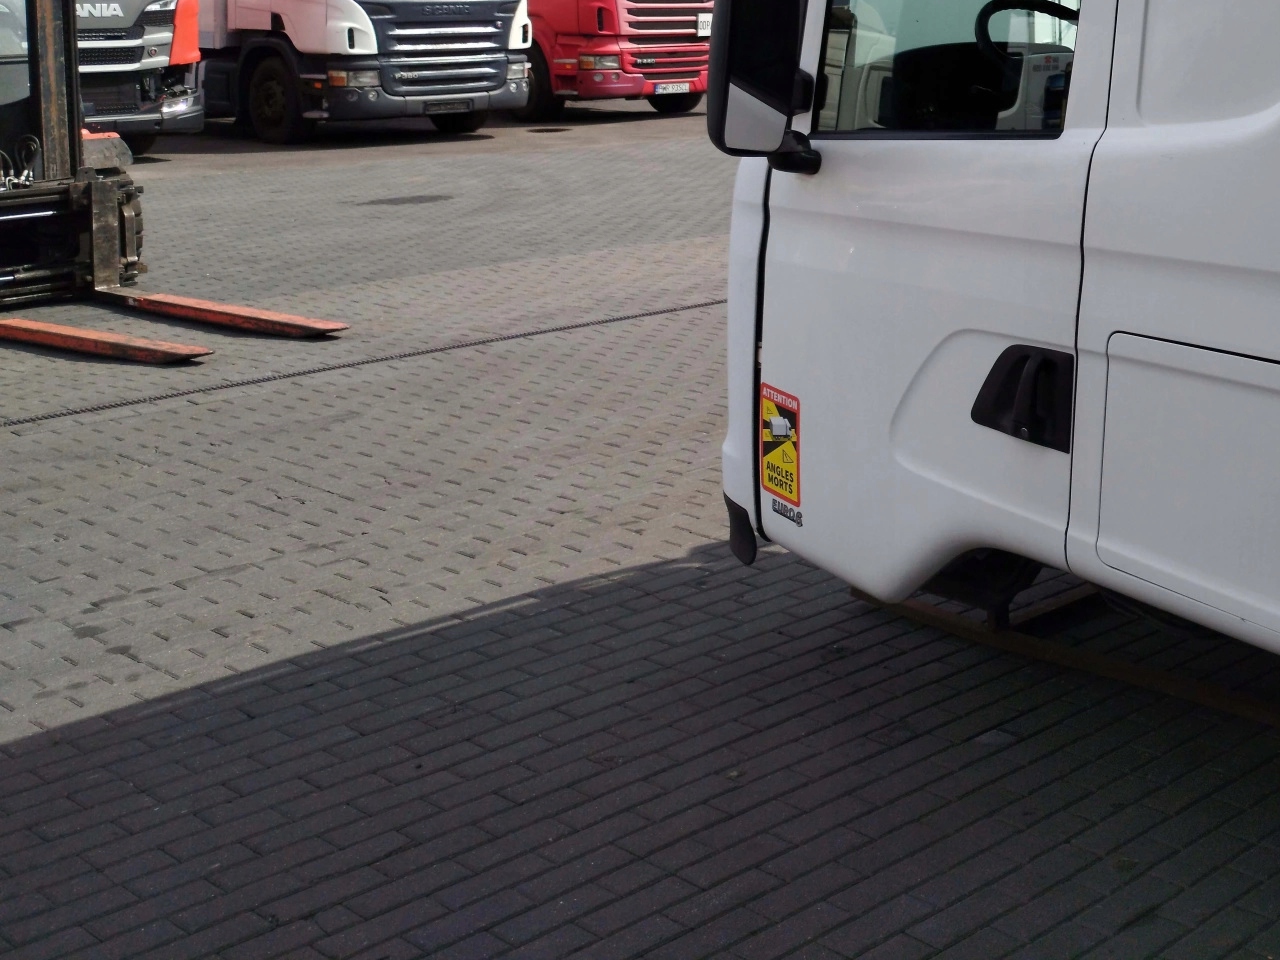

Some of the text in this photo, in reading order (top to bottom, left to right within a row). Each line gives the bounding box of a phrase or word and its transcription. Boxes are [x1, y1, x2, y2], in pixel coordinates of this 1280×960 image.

[76, 3, 124, 18] ANIA
[762, 386, 798, 411] ATTENTION
[766, 460, 794, 483] ANGLES
[768, 472, 793, 495] MORTS
